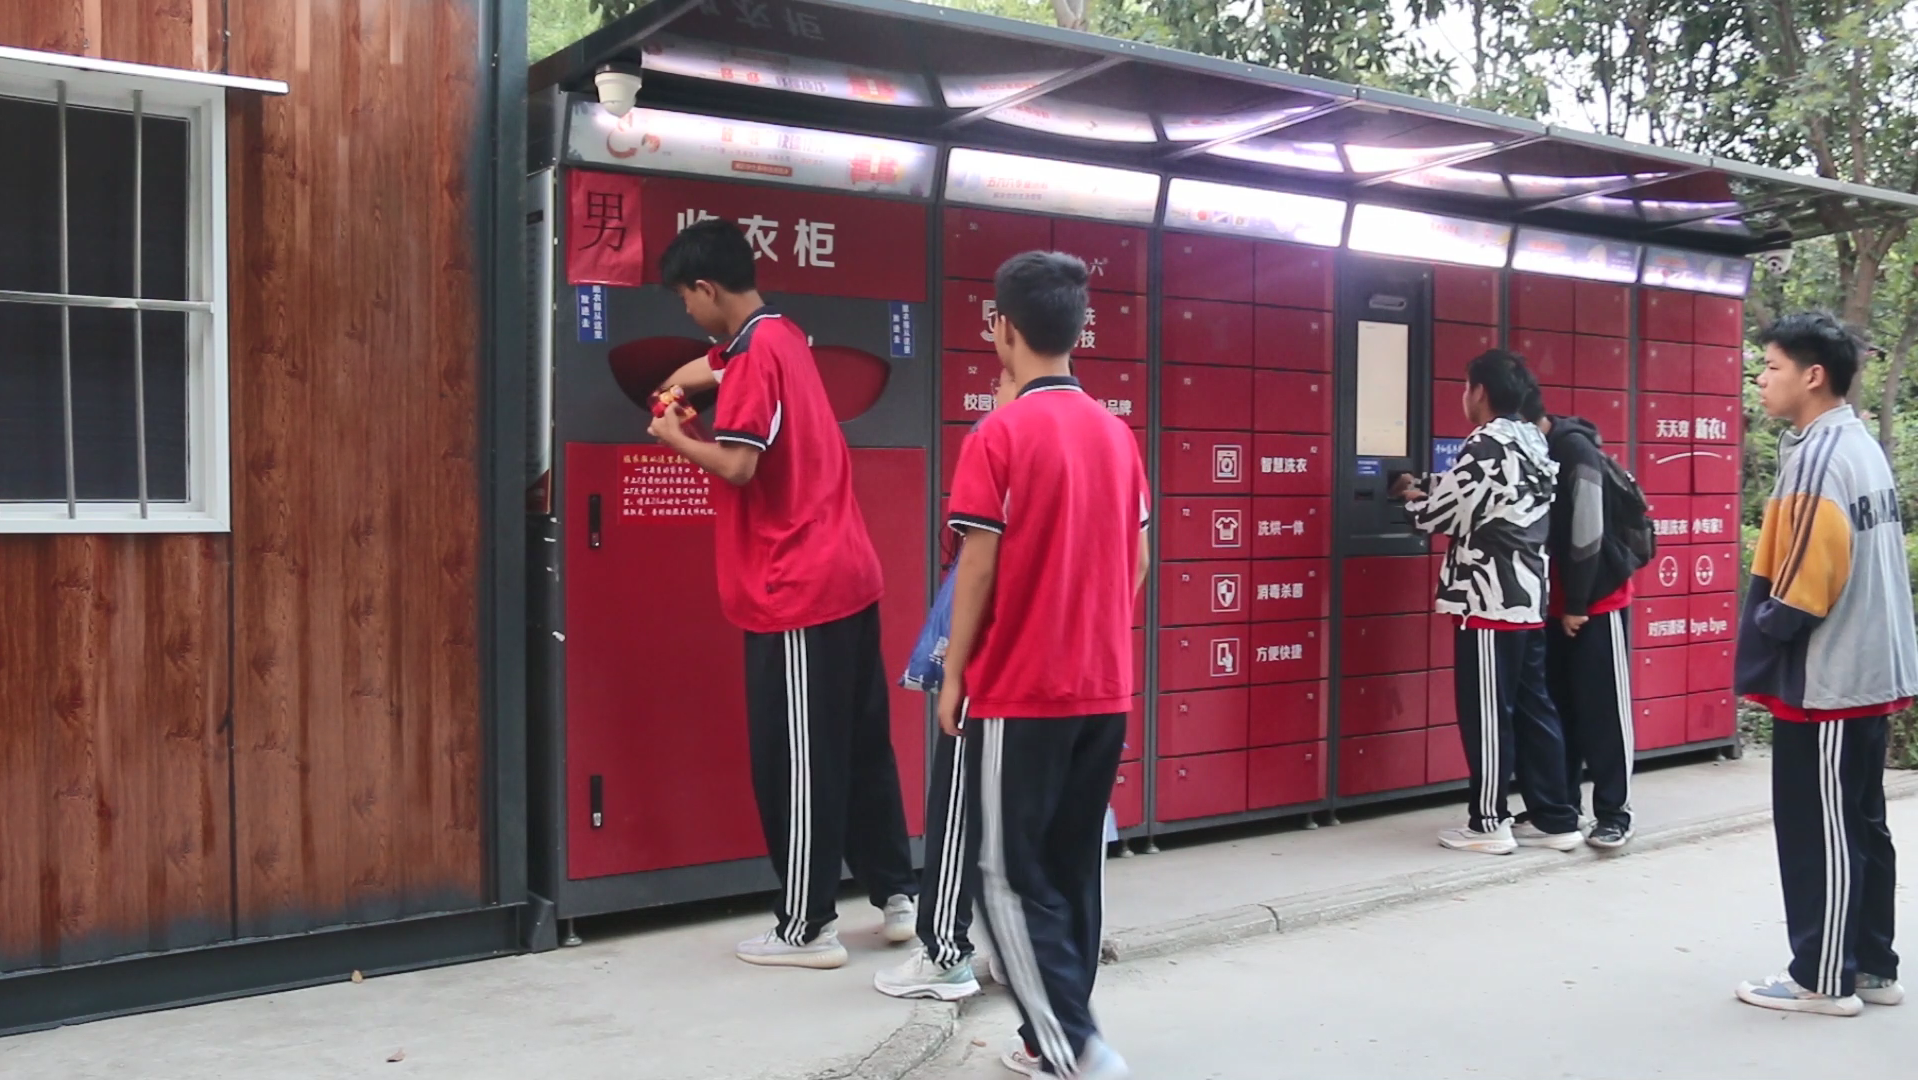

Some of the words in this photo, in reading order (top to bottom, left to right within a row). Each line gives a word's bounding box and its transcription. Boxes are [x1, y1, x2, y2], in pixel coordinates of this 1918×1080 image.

[578, 191, 627, 252] 男
[963, 393, 998, 412] 校园
[1098, 399, 1133, 416] 品牌
[1260, 457, 1308, 473] 智慧洗衣
[1257, 520, 1305, 536] 洗烘一体
[1256, 582, 1304, 600] 消毒杀菌
[1690, 618, 1708, 636] bye
[1709, 617, 1727, 634] bye
[1256, 644, 1303, 662] 方便快捷
